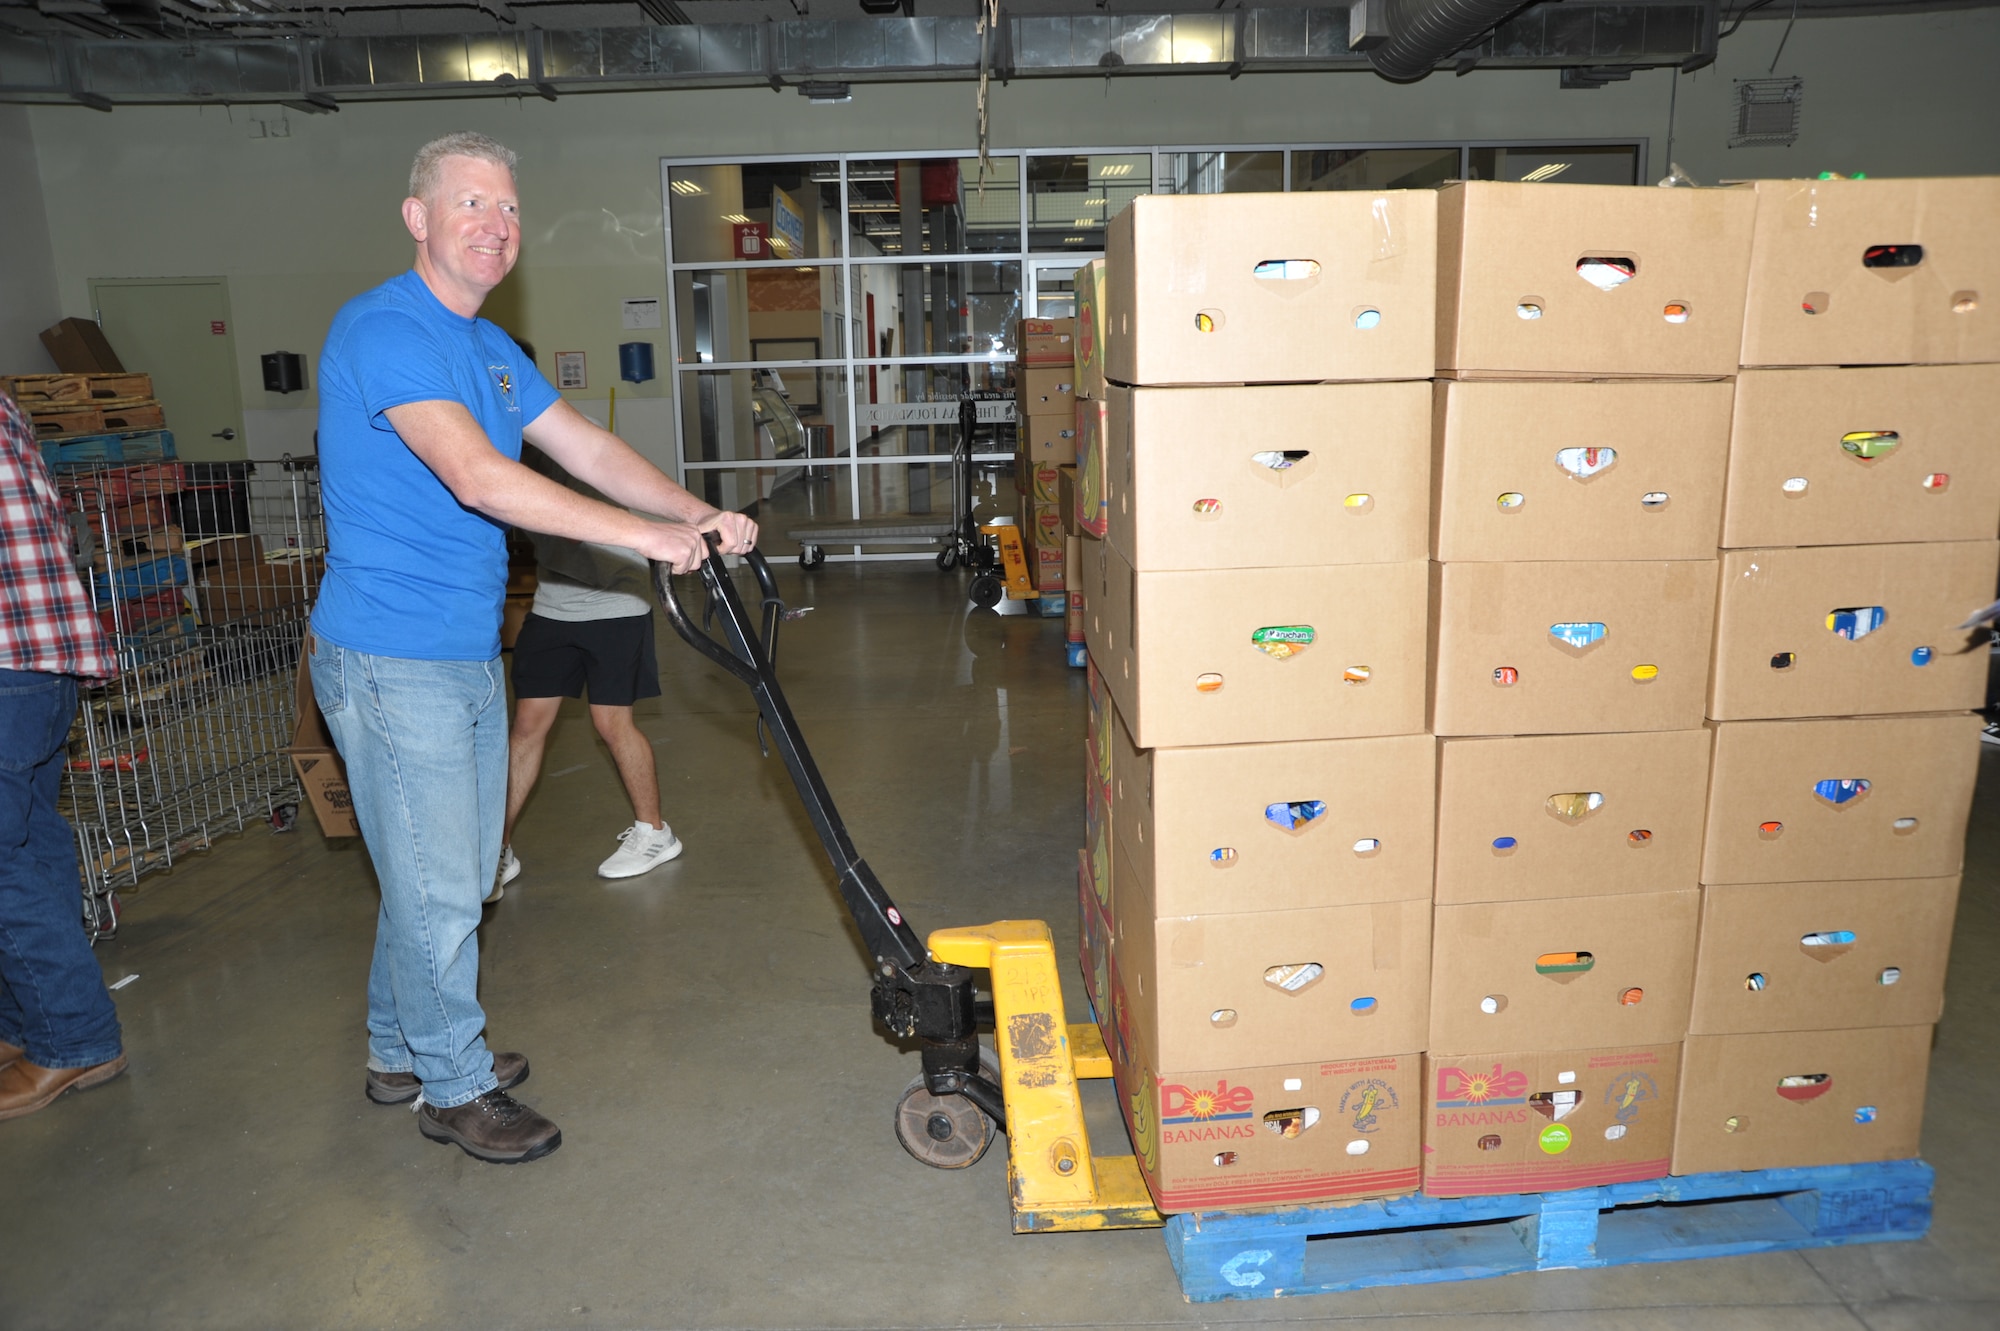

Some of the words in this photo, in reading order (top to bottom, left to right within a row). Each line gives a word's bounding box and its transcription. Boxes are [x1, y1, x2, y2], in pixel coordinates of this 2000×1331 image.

[1027, 322, 1054, 334] Dole
[1358, 1058, 1396, 1066] GUATEMALA
[1350, 1079, 1366, 1091] WITH
[1372, 1078, 1387, 1090] COOL
[1436, 1063, 1529, 1103] Dole
[1161, 1079, 1255, 1118] Dole
[1437, 1108, 1528, 1127] BANANAS
[1163, 1123, 1256, 1144] BANANAS
